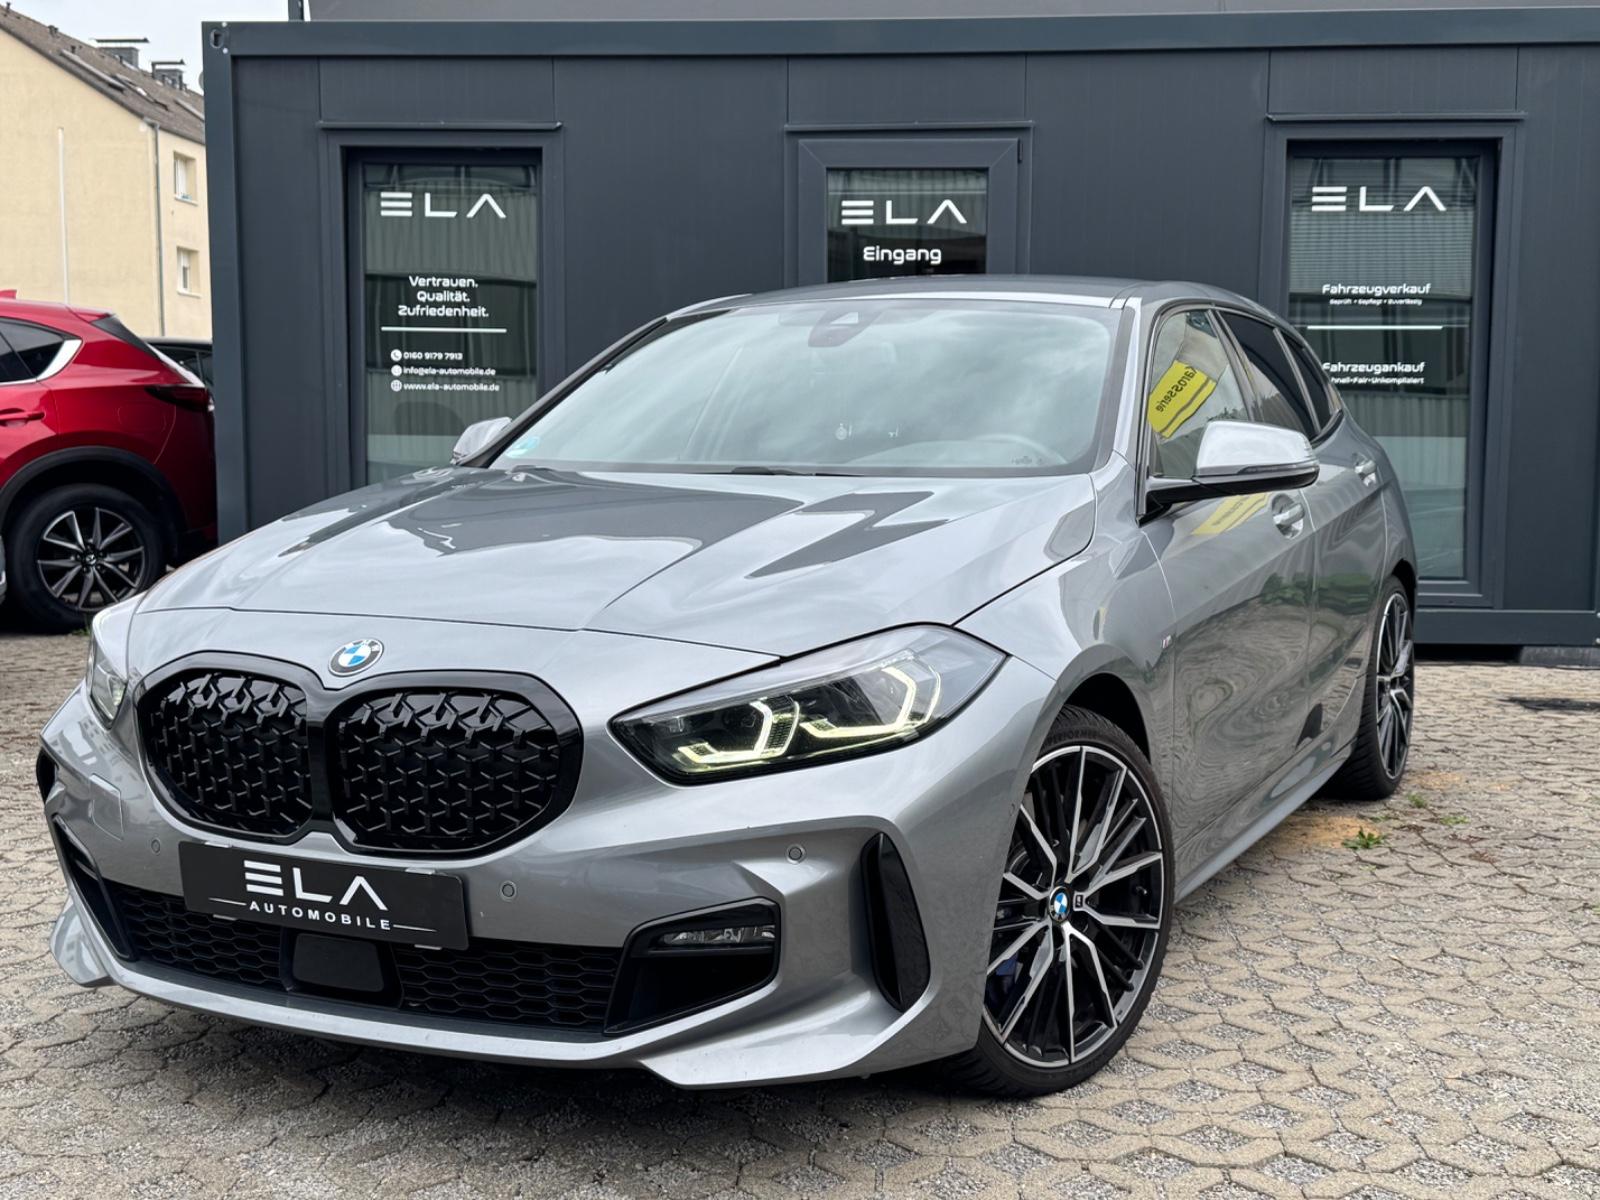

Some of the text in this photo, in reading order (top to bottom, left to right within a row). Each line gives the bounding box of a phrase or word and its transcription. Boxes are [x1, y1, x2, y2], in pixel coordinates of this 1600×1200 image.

[380, 191, 507, 218] ELA
[1311, 186, 1447, 212] ELA
[841, 199, 968, 225] ELA
[863, 245, 942, 265] Eingang
[408, 275, 479, 288] Vertrauen.
[1321, 282, 1431, 296] Fahrzeugverkauf
[416, 290, 471, 303] Qualität.
[398, 304, 489, 317] Zufriedenheit.
[1322, 361, 1425, 375] Fahrzeugankauf
[243, 859, 389, 911] ELA
[249, 900, 392, 931] AUTOMOBILE
